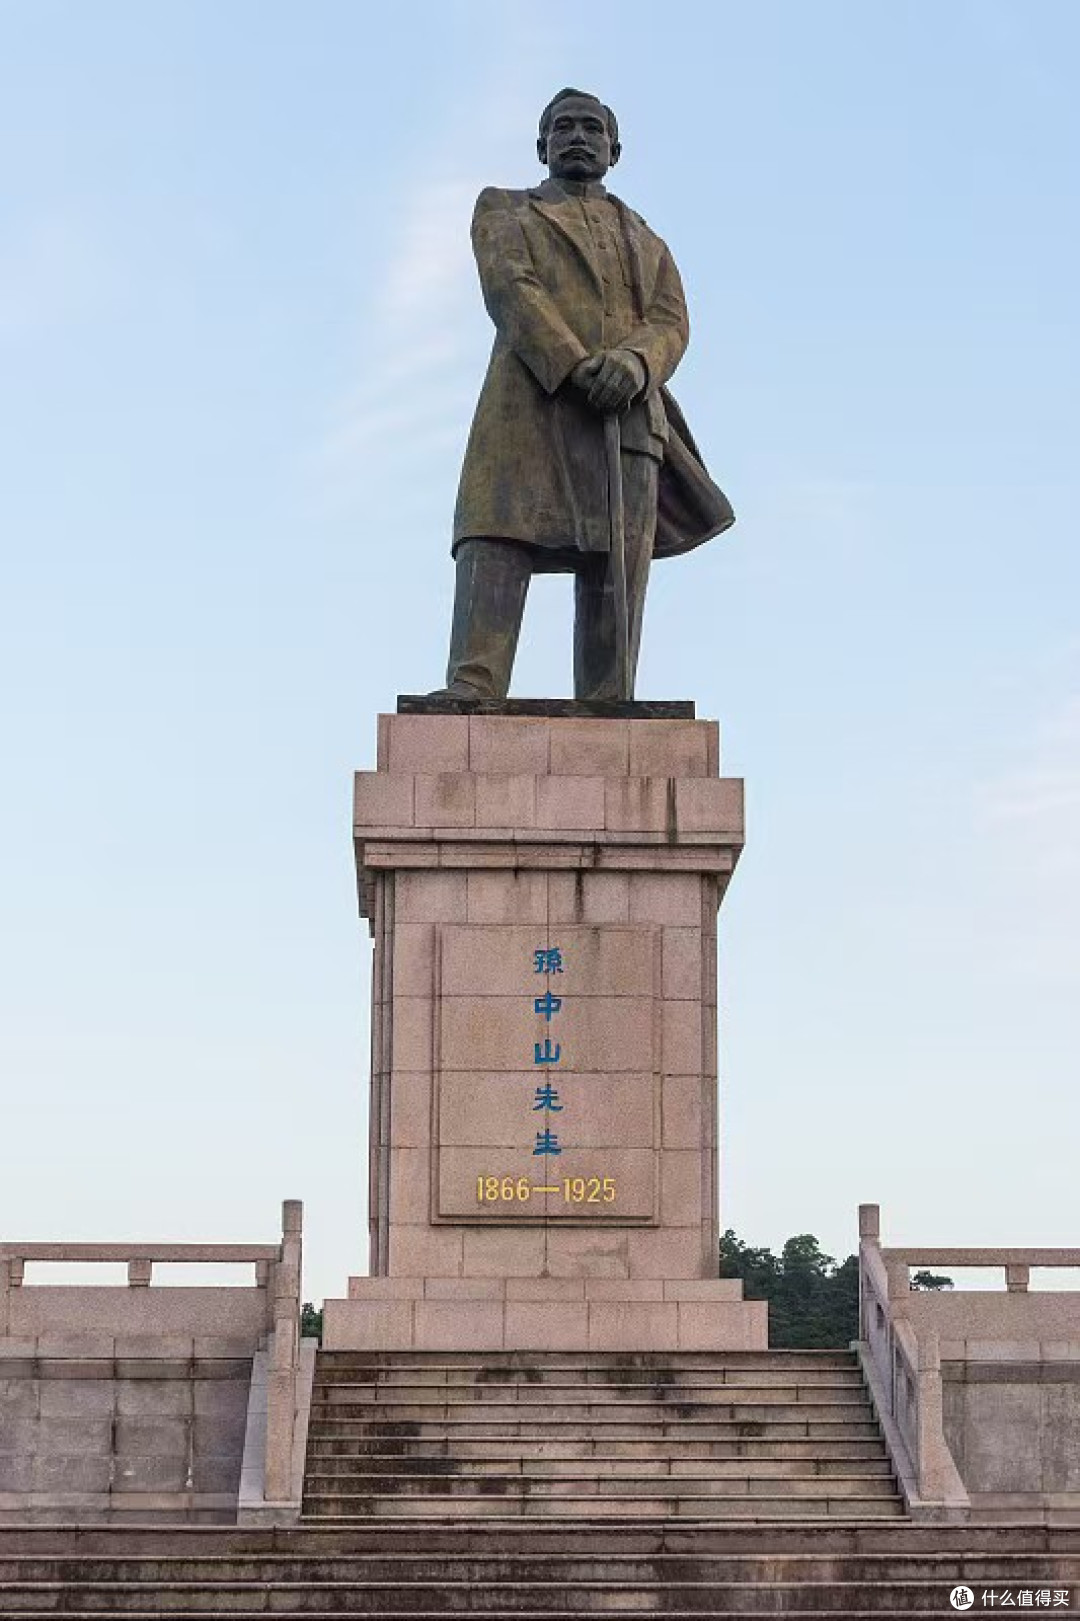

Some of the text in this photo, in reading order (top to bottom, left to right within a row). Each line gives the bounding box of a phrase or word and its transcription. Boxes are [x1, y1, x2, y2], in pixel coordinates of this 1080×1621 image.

[533, 948, 563, 1156] 孫中山先生
[476, 1176, 617, 1204] 1866—1925
